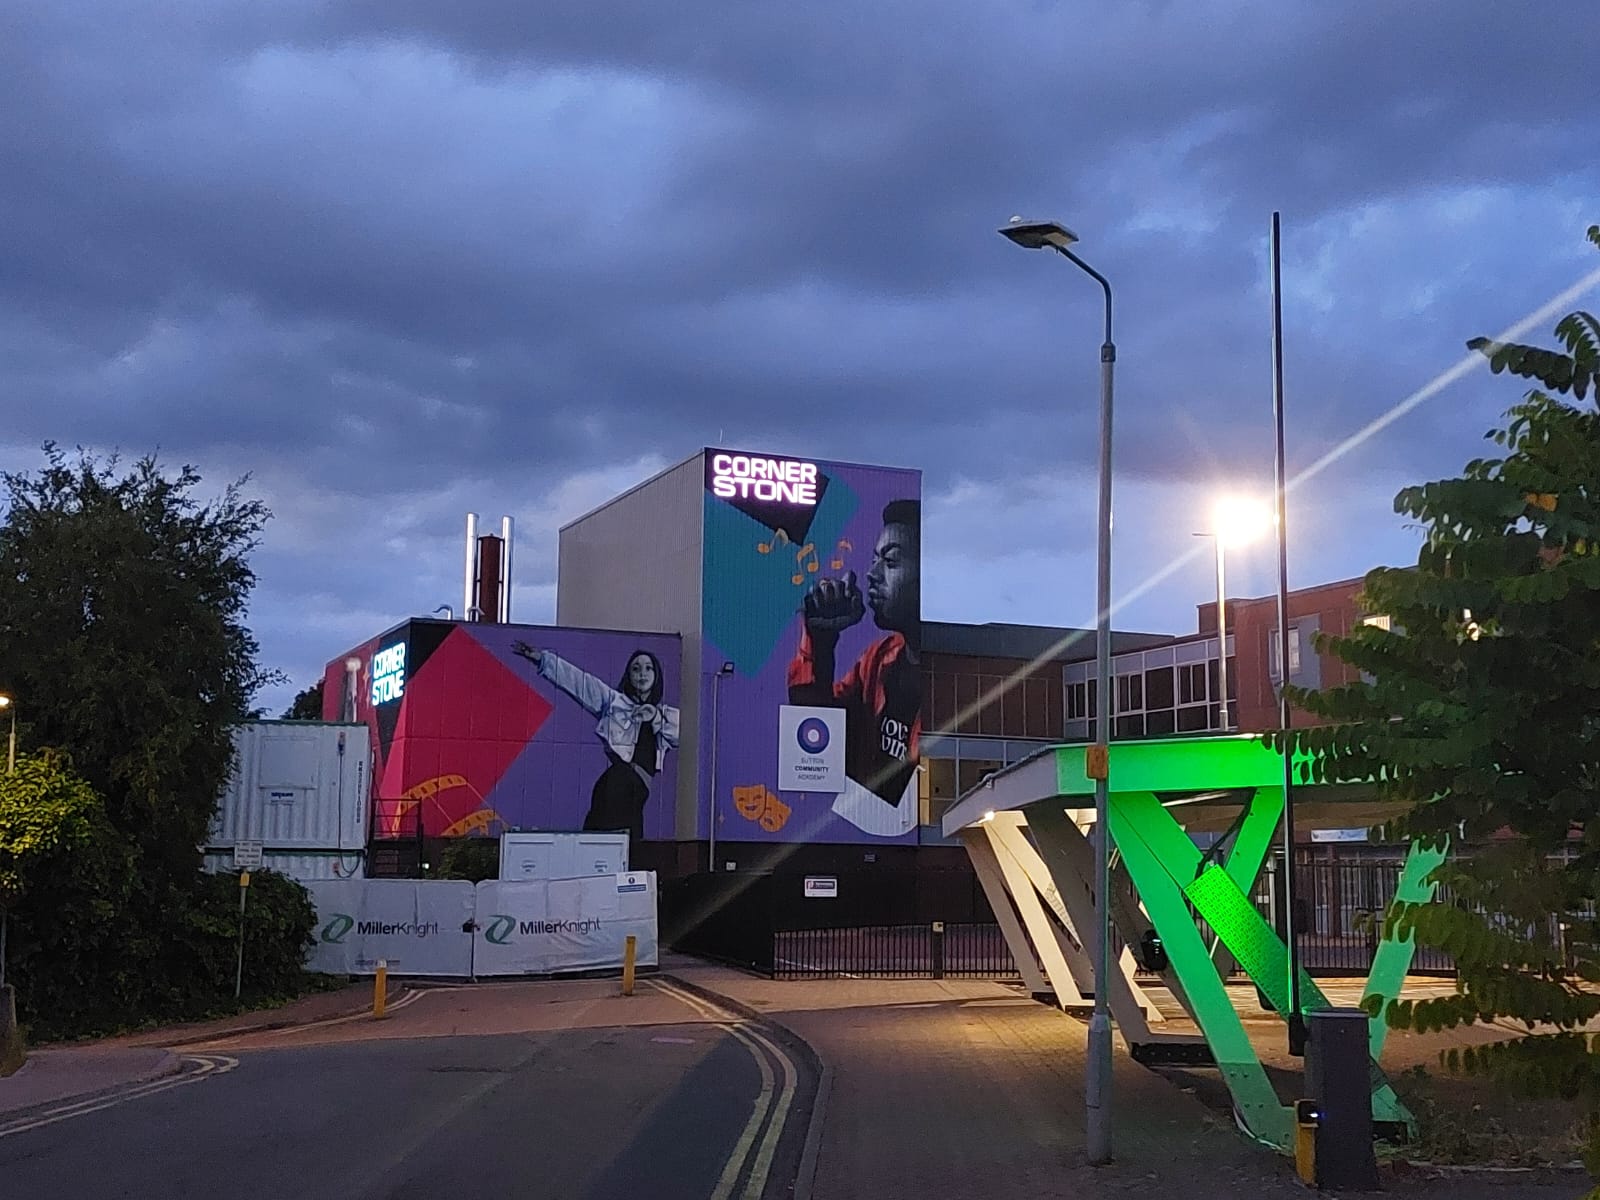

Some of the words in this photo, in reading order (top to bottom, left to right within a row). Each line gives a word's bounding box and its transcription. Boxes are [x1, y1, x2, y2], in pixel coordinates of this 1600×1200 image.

[713, 454, 817, 483] CORNER
[713, 475, 817, 505] STONE
[373, 642, 406, 679] CORNER
[372, 669, 405, 706] STONE
[794, 765, 829, 773] COMMUNITY
[357, 921, 438, 938] MillerKnight
[520, 917, 601, 935] MillerKnight
